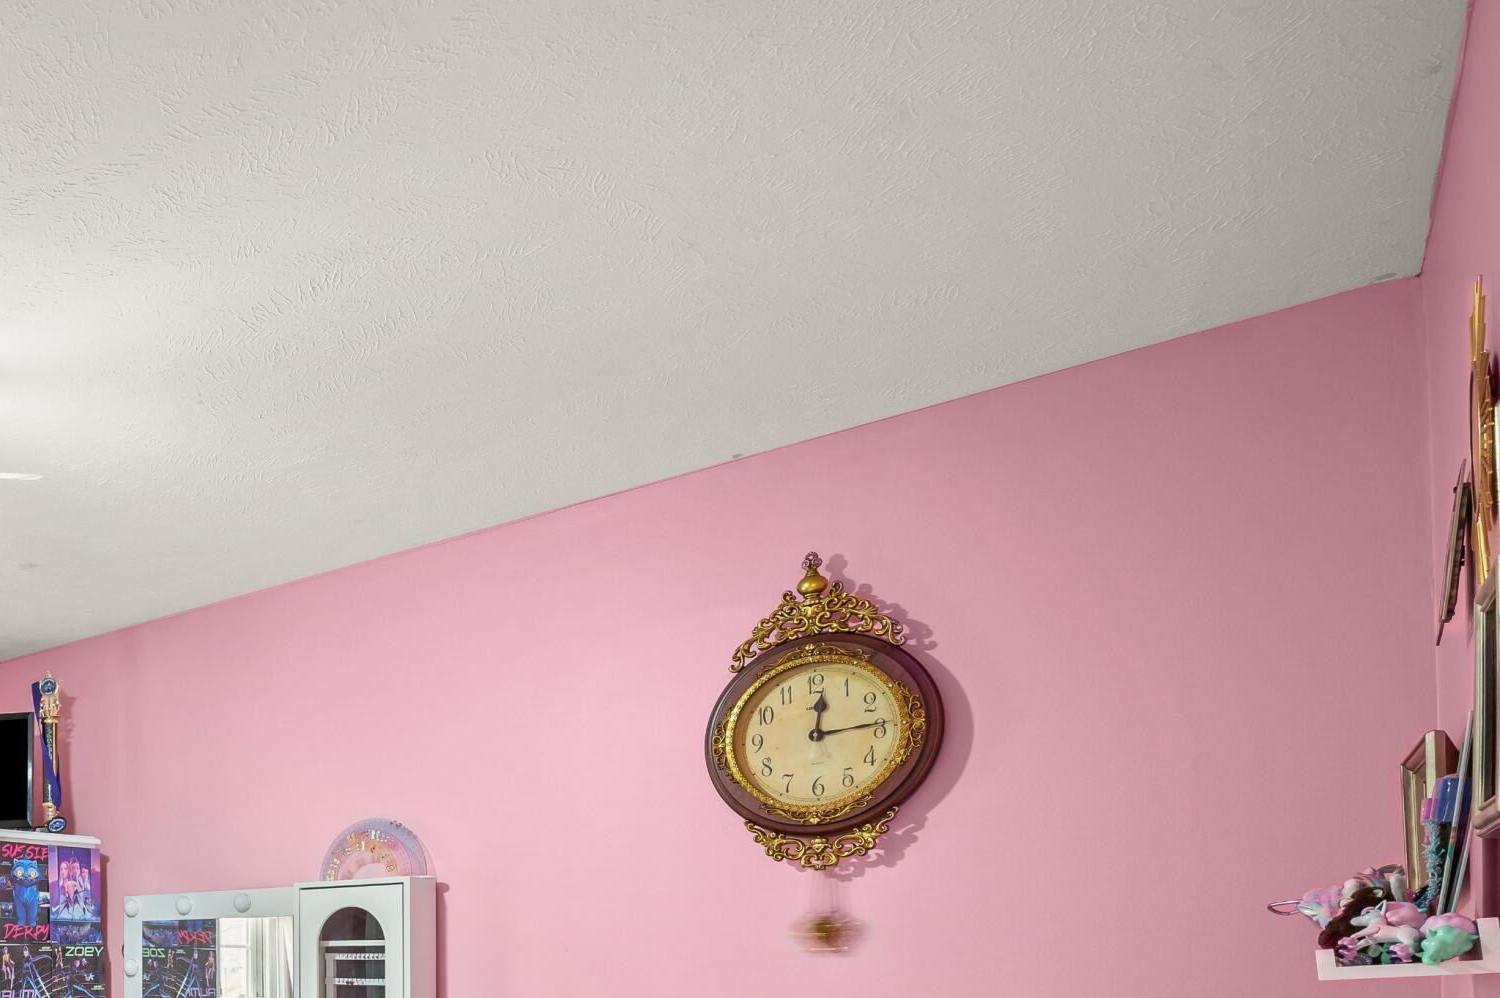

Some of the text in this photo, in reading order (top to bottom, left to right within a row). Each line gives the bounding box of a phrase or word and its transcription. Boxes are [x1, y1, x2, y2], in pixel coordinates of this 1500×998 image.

[780, 685, 792, 705] 11
[807, 674, 825, 697] 12
[844, 676, 849, 697] 1
[863, 691, 877, 713] 2
[758, 706, 775, 726] 10
[873, 717, 887, 739] 3
[751, 733, 764, 754] 9
[863, 745, 877, 766] 4
[761, 756, 773, 777] 8
[781, 773, 794, 794] 7
[812, 776, 825, 797] 6
[842, 767, 854, 788] 5
